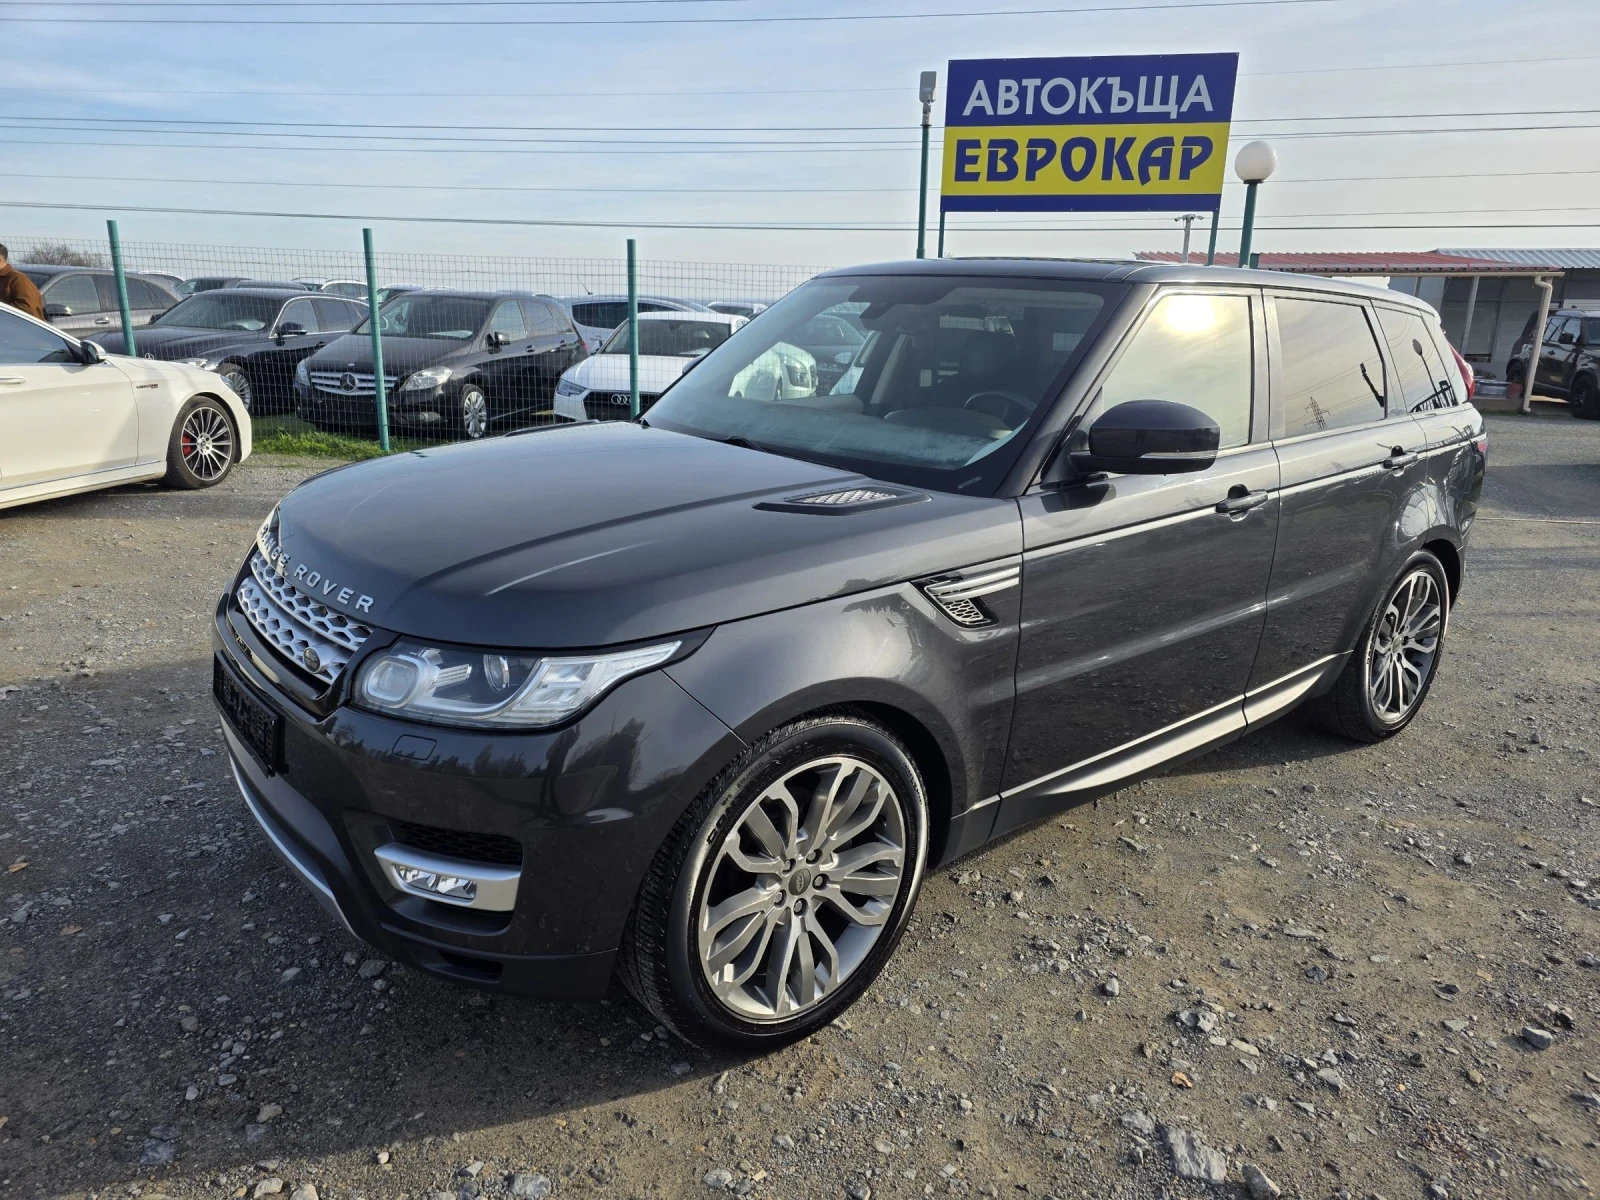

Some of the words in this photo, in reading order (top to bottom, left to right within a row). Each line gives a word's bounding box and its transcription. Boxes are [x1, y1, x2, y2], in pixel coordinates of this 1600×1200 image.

[962, 74, 1214, 119] АВТОКЪЩА
[954, 136, 1213, 186] ЕВРОКАР
[293, 563, 374, 614] ROVER
